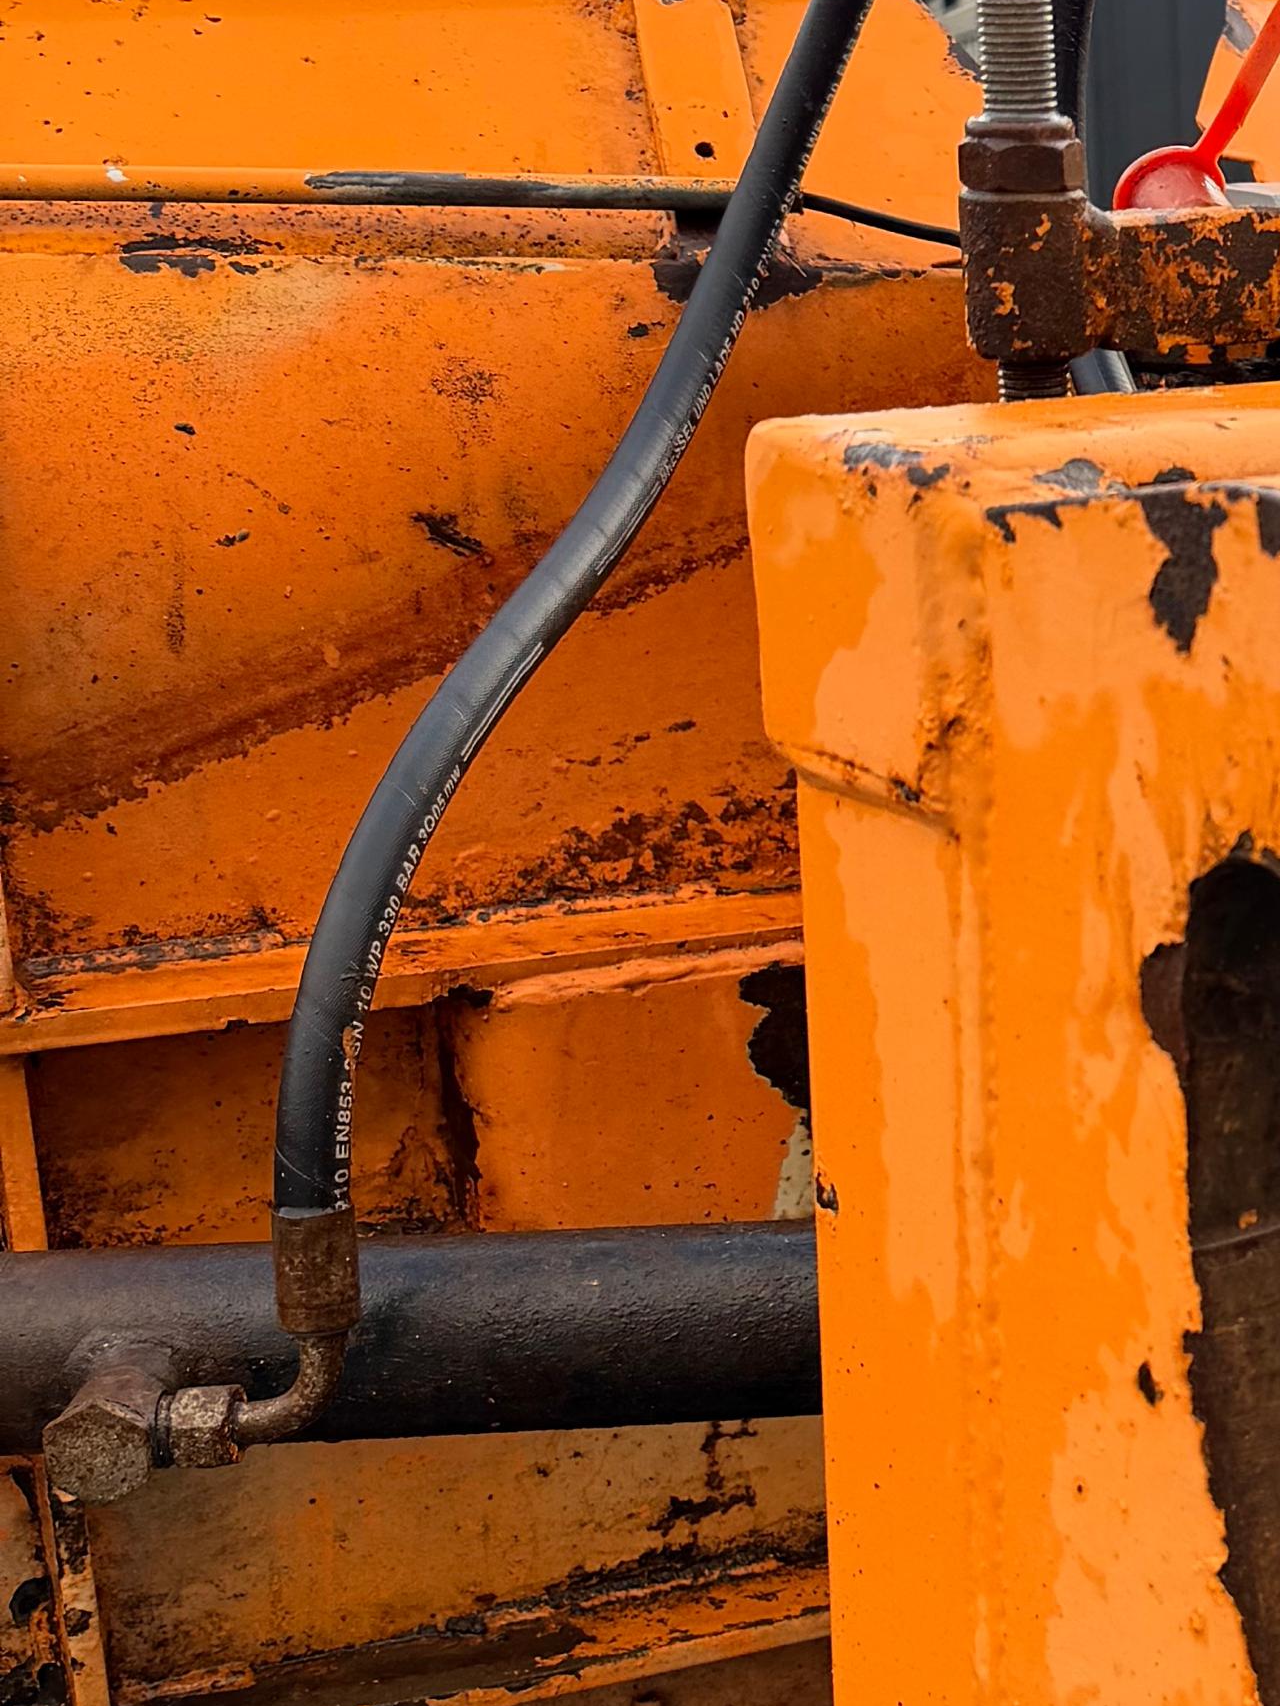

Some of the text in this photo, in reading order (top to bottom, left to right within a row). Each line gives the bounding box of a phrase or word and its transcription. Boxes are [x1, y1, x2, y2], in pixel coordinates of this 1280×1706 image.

[692, 383, 712, 420] UND
[335, 1080, 353, 1160] EN853
[356, 985, 372, 1012] 10
[364, 940, 382, 979] WP
[378, 895, 401, 937] 330
[395, 844, 421, 894] BAR
